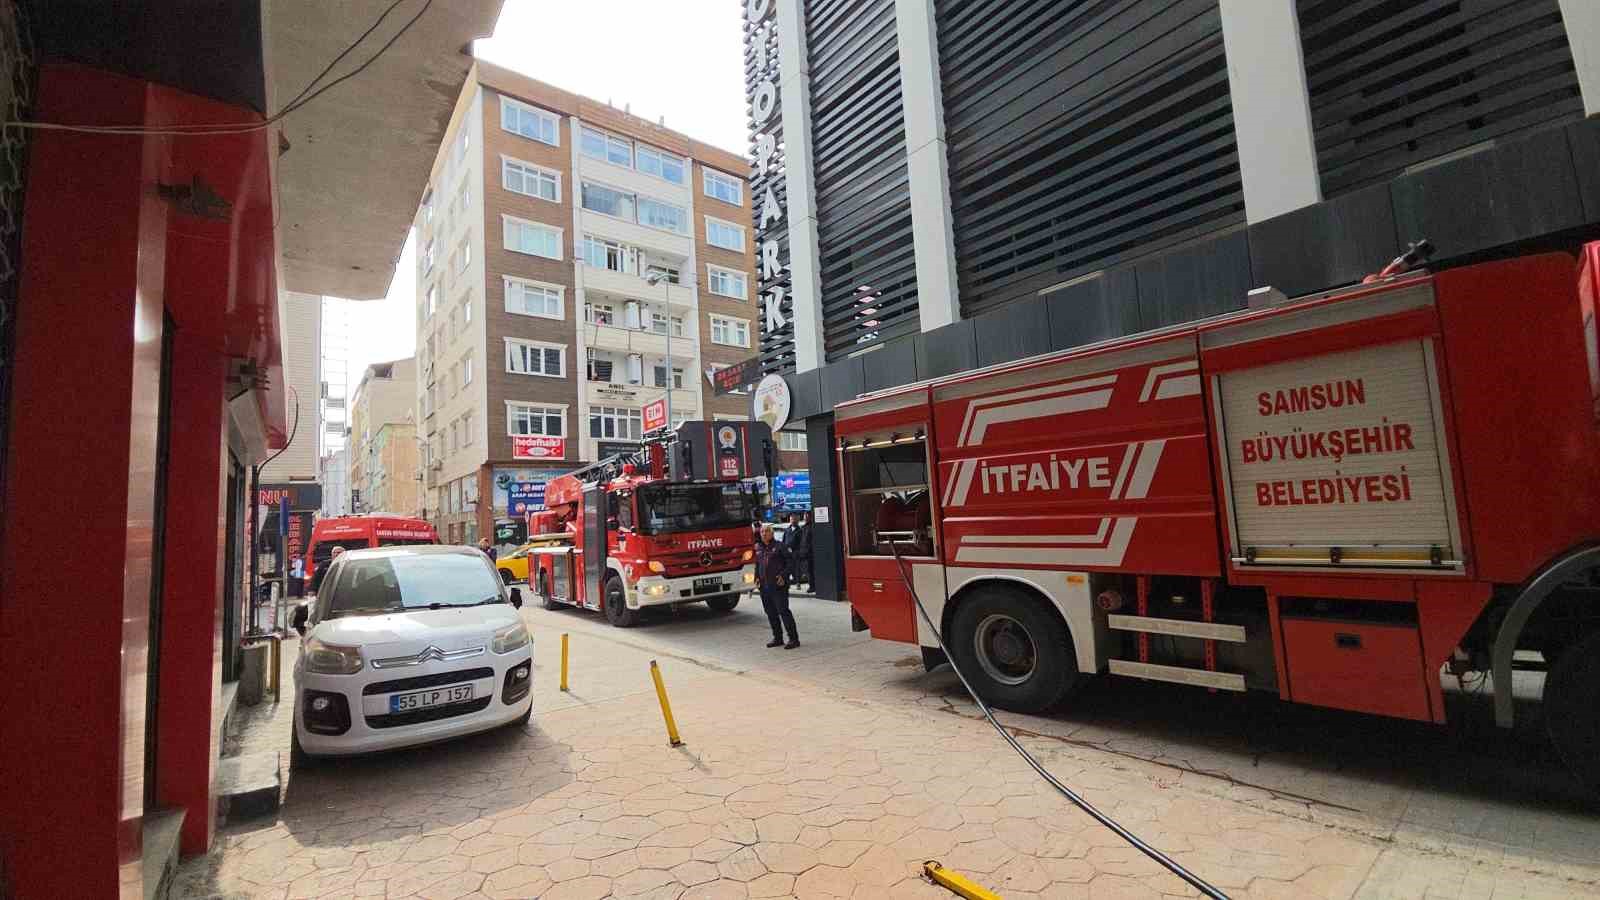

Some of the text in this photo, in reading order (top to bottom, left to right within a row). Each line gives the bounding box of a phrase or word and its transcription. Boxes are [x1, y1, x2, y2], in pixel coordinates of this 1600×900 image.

[1257, 378, 1366, 416] SAMSUN
[1241, 416, 1415, 463] BÜYÜKŞEHİR
[723, 459, 737, 469] 112
[980, 454, 1112, 494] İTFAİYE
[1256, 464, 1412, 506] BELEDİYESİ
[399, 686, 471, 709] 55 LP 157
